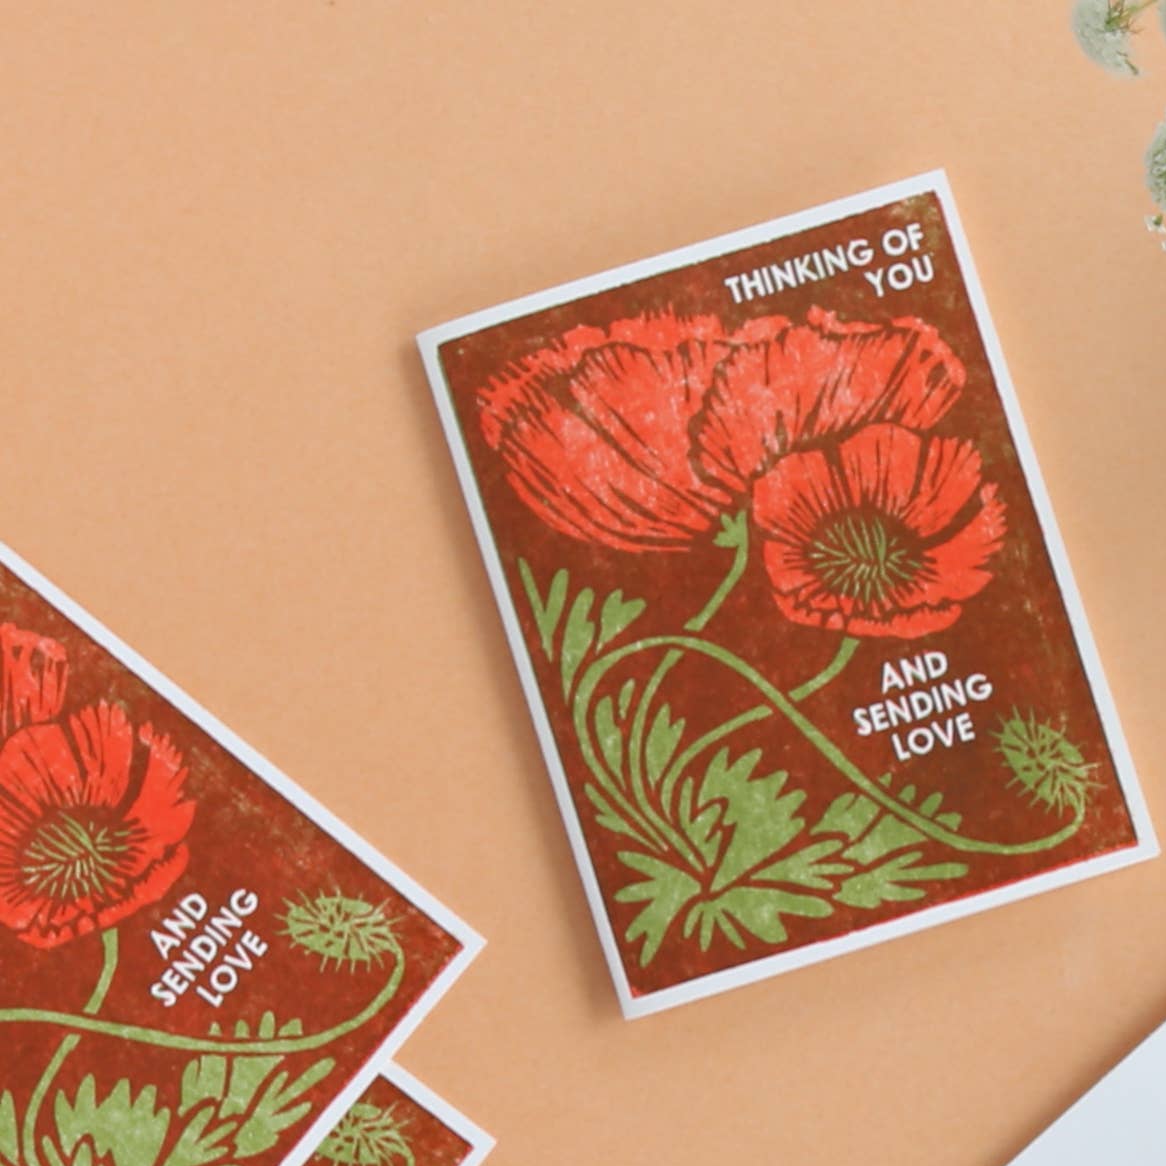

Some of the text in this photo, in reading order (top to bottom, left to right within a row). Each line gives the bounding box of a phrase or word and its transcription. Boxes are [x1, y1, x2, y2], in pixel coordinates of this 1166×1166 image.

[724, 223, 925, 304] THINKING OF
[864, 256, 935, 298] YOU
[853, 673, 993, 737] SENDING
[881, 651, 949, 694] AND
[891, 713, 975, 762] LOVE
[150, 893, 208, 960] AND
[150, 888, 259, 1007] SENDING
[196, 930, 268, 1008] LOVE
